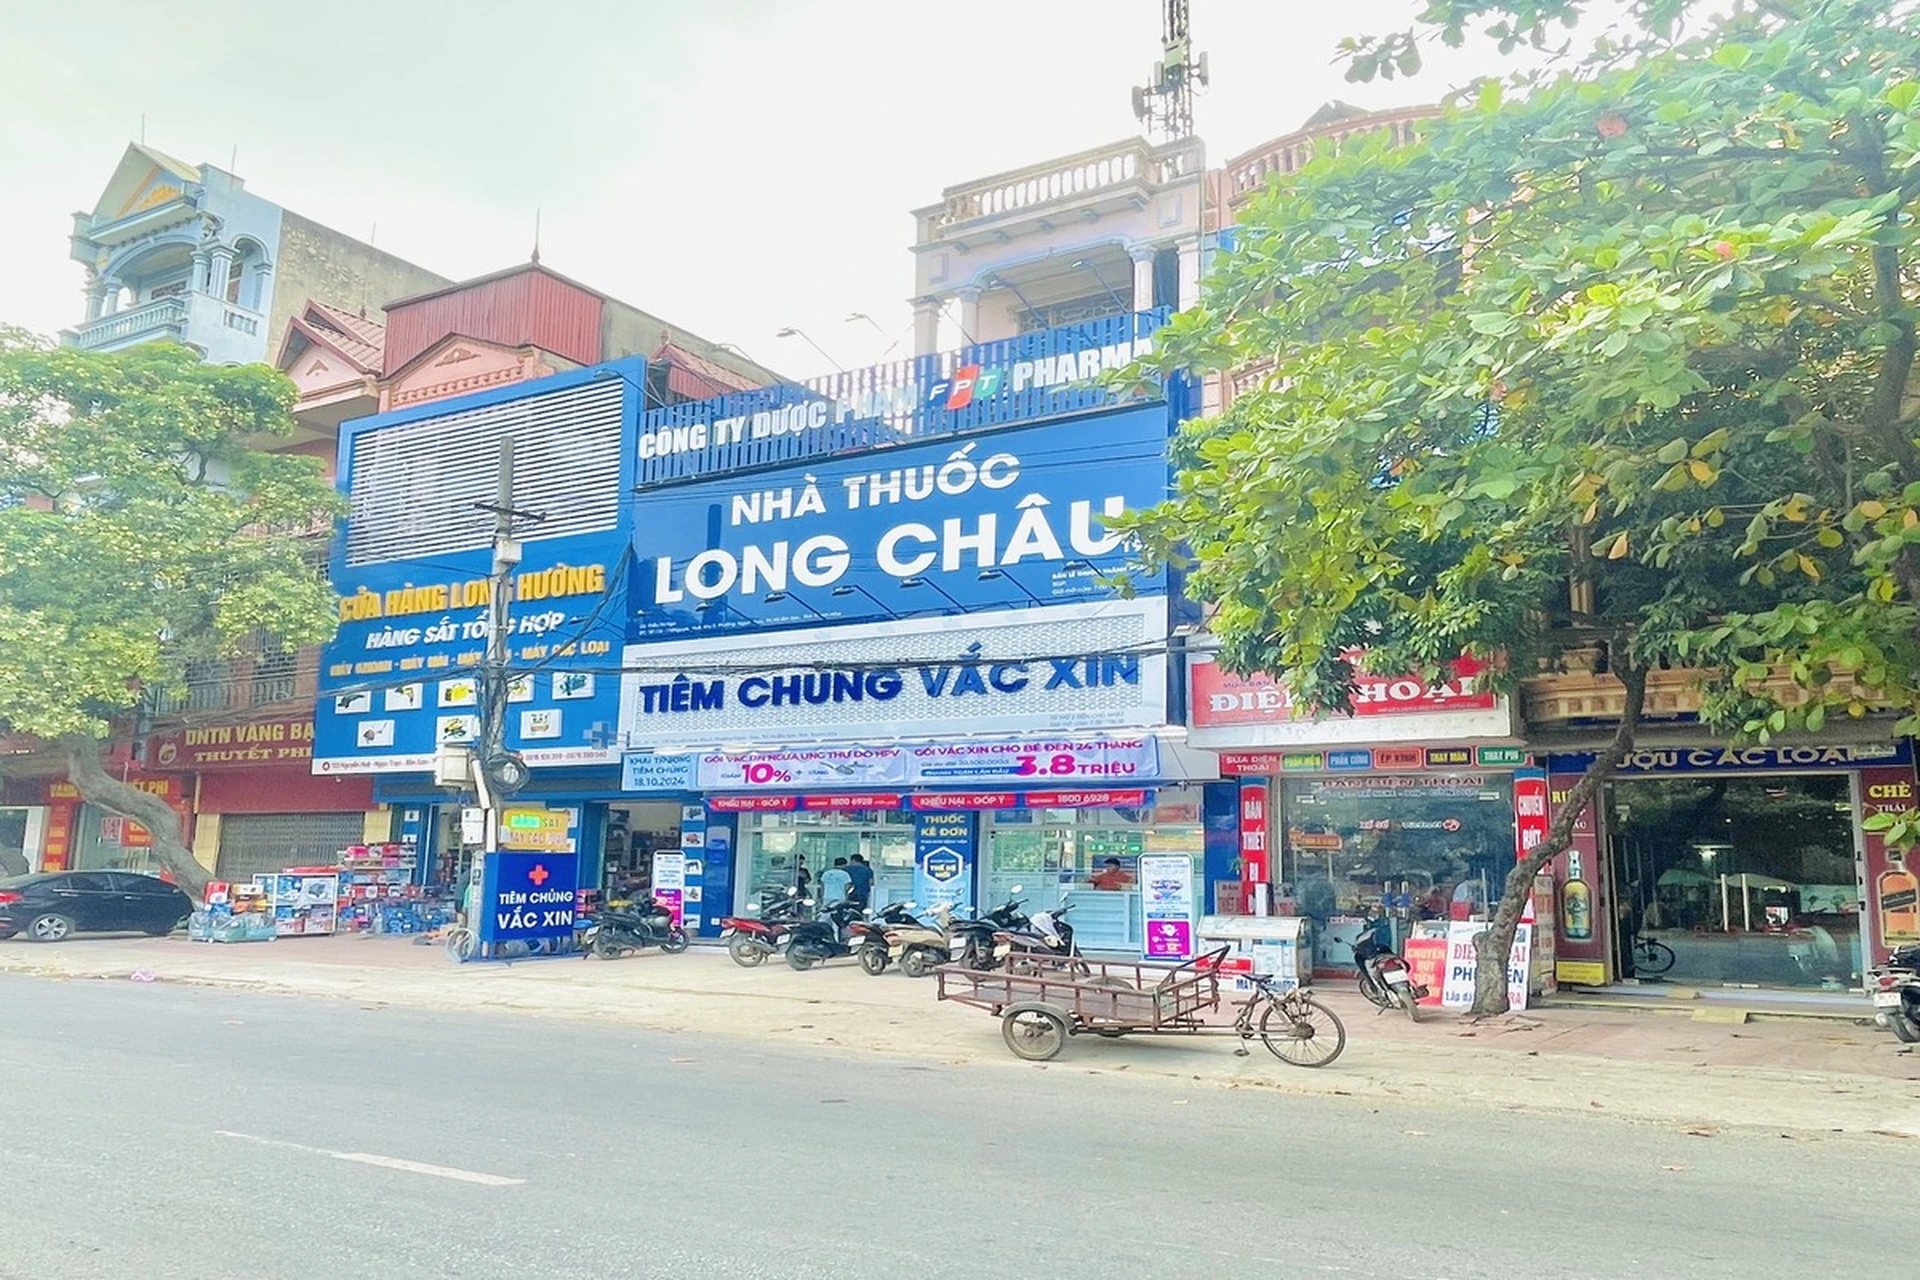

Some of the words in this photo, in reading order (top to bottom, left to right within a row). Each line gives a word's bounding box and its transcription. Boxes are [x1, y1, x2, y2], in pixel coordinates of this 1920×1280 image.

[638, 424, 708, 460] CÔNG
[714, 416, 747, 446] TY
[752, 400, 828, 438] DƯỢC
[927, 371, 999, 403] FPT
[731, 474, 827, 528] NHÀ
[842, 442, 1021, 511] THUỐC
[654, 535, 852, 604] LONG
[877, 494, 1127, 578] CHÂU
[385, 583, 449, 617] HÀNG
[366, 626, 424, 650] HÀNG
[423, 616, 455, 645] SẮT
[519, 610, 566, 638] HỢP
[639, 673, 725, 714] TIÊM
[918, 641, 1029, 698] VẮC
[1044, 655, 1139, 690] XIN
[185, 727, 231, 746] DNTN
[236, 722, 284, 743] VÀNG
[195, 744, 273, 763] THUYẾT
[991, 744, 1022, 753] CHO
[742, 762, 792, 784] 10%
[1015, 754, 1076, 777] 3.8
[1077, 760, 1136, 777] TRIỆU
[973, 794, 997, 806] GÓP
[1057, 793, 1082, 804] 1800
[1083, 793, 1110, 804] 6928
[1868, 783, 1912, 799] CHÈ
[923, 812, 967, 824] THUỐC
[498, 890, 527, 905] TIÊM
[529, 888, 574, 904] CHỦNG
[497, 905, 538, 929] VẮC
[542, 910, 574, 927] XIN
